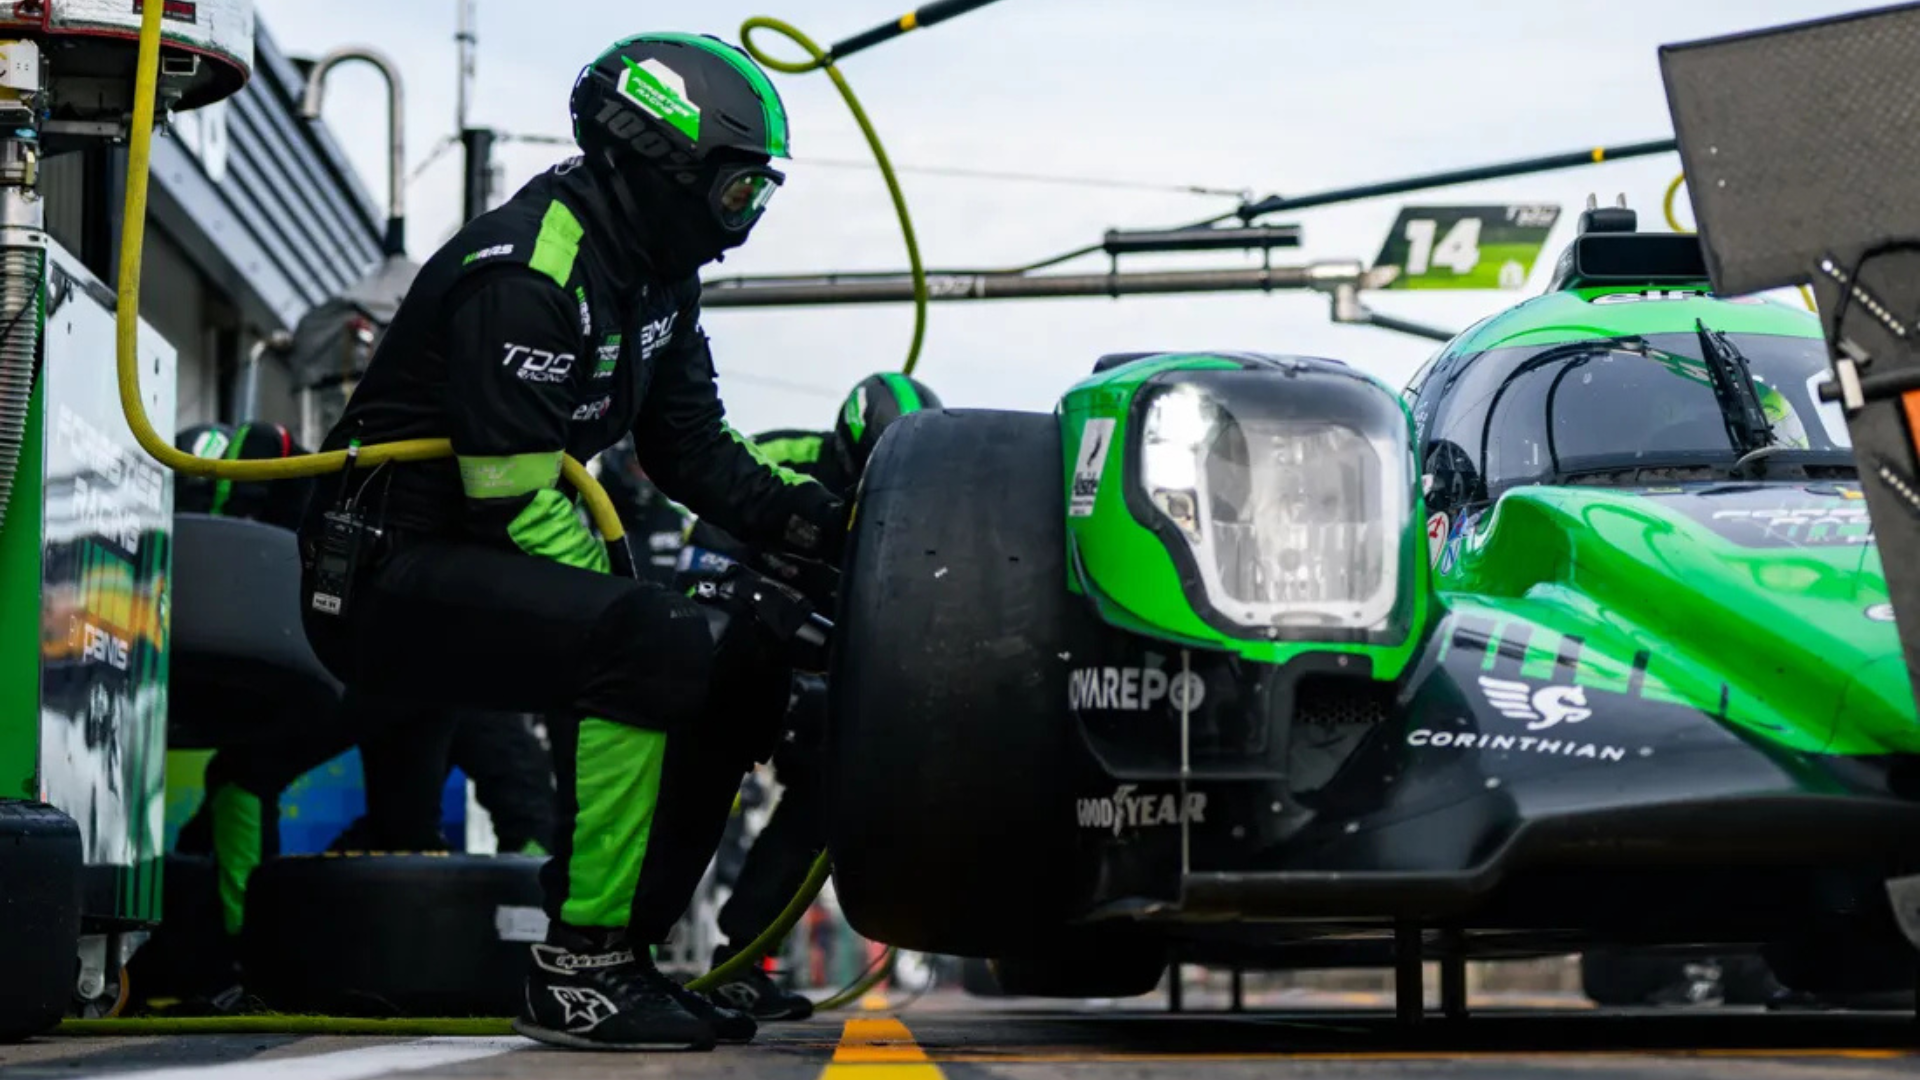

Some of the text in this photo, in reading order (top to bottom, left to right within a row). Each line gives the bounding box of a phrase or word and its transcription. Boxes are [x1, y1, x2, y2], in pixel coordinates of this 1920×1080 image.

[595, 98, 705, 186] 100%
[1405, 217, 1482, 275] 14
[502, 342, 576, 374] TDS
[1407, 728, 1626, 762] CORINTHIAN
